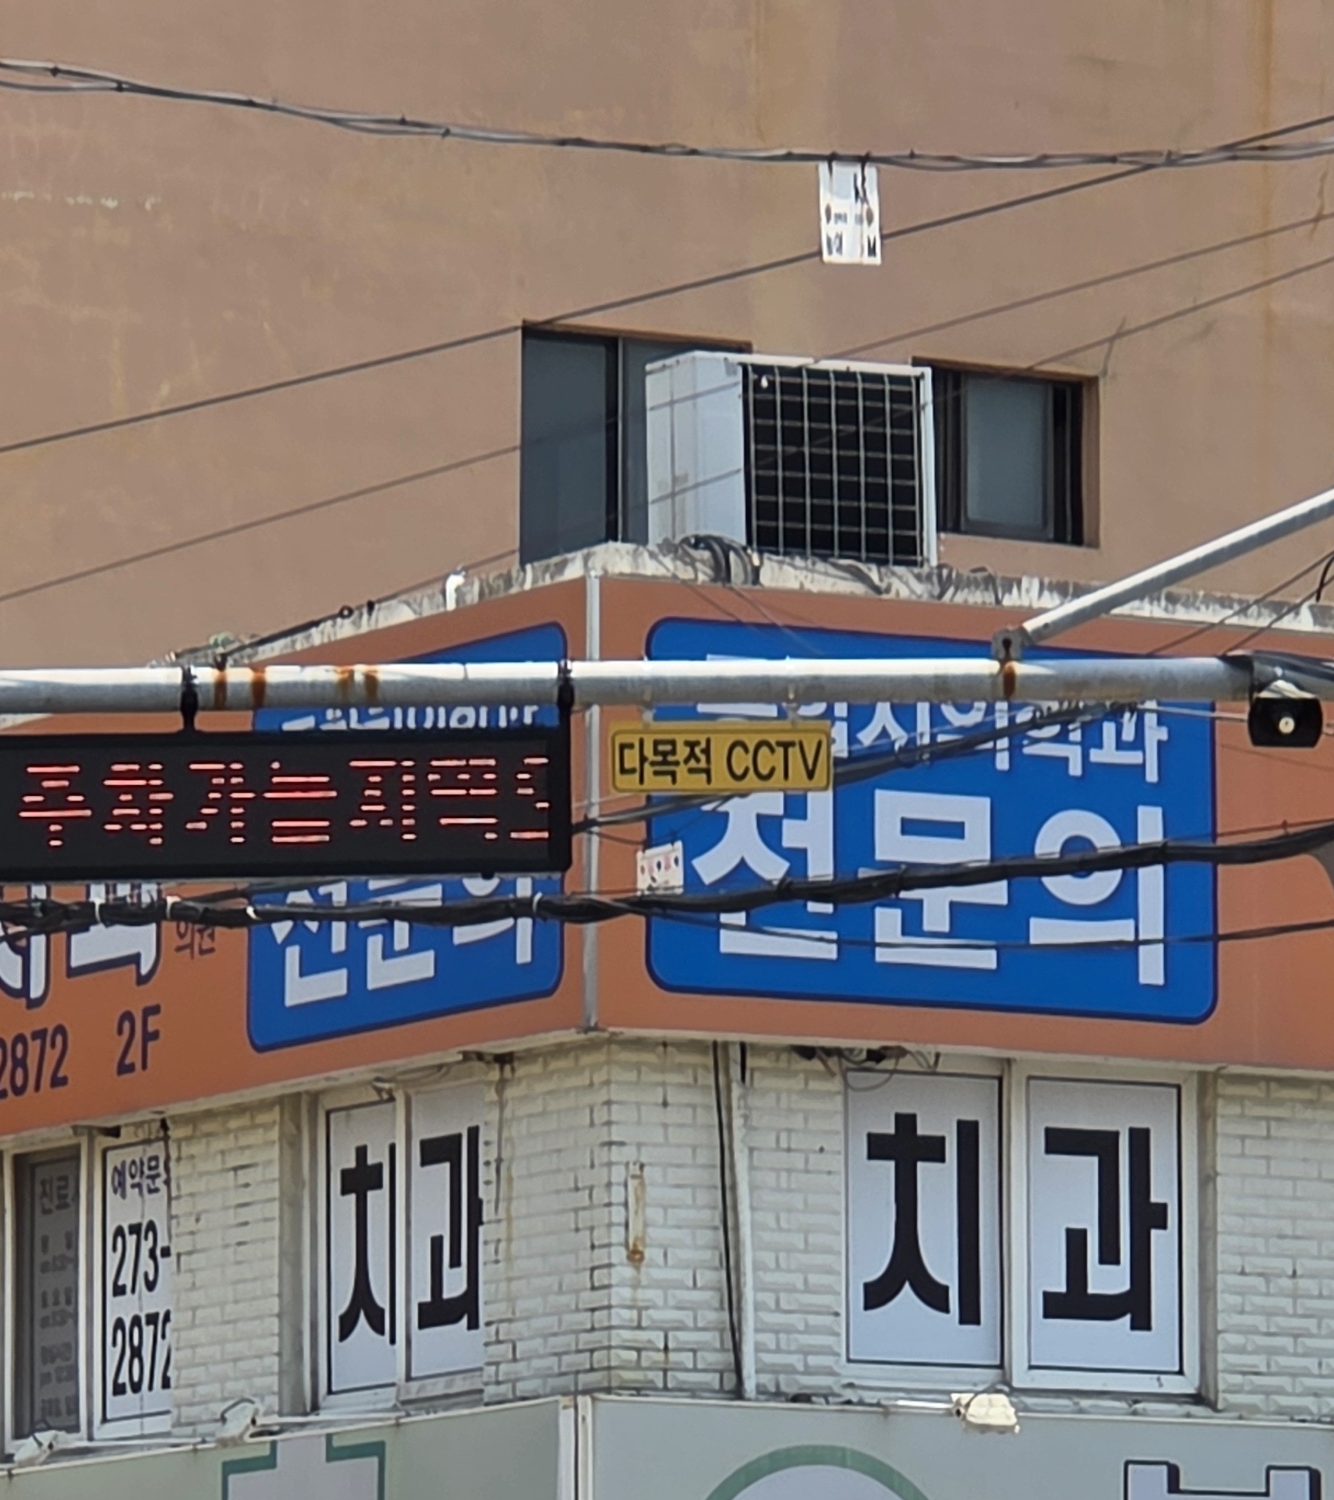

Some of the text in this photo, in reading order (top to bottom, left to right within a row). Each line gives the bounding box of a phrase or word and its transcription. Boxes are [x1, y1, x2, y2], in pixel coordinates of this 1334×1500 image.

[617, 739, 824, 786] 다목적 CCTV
[692, 785, 1165, 986] 전문의
[115, 1005, 162, 1077] 2F
[111, 1154, 168, 1200] 예약문
[338, 1125, 484, 1345] 치과
[863, 1112, 1168, 1331] 치과
